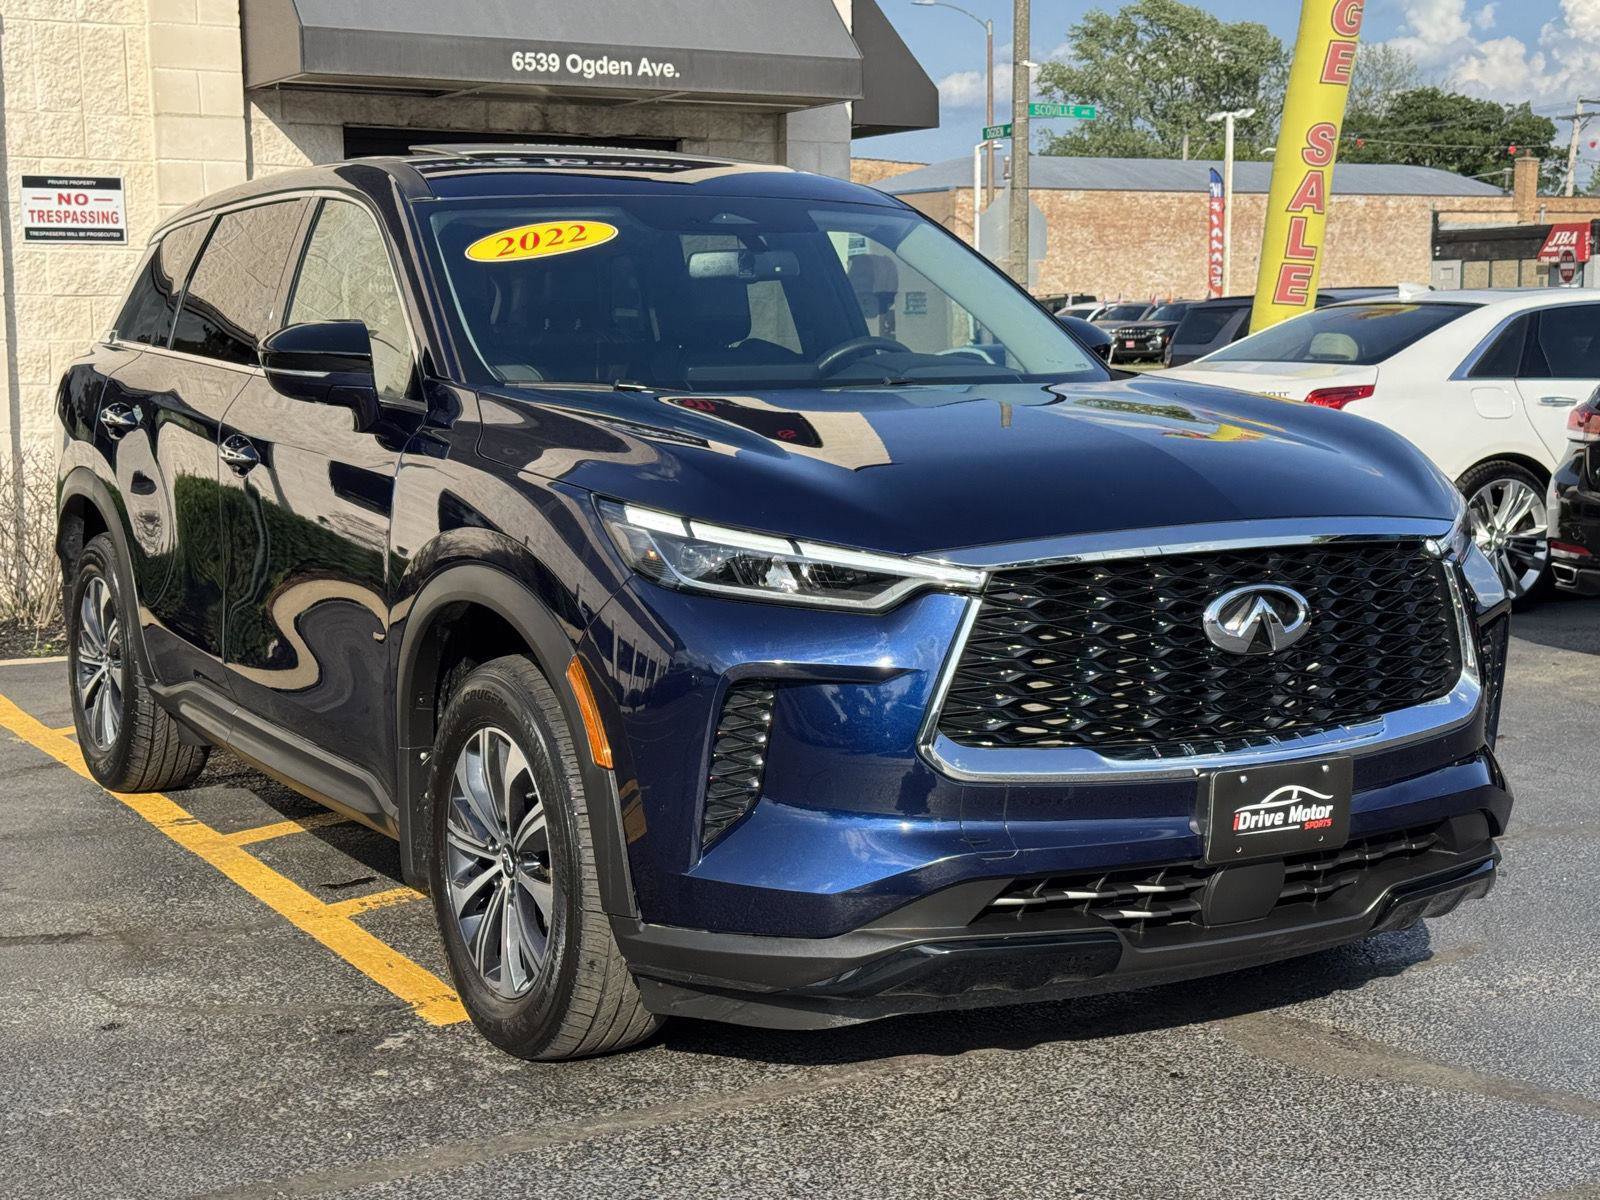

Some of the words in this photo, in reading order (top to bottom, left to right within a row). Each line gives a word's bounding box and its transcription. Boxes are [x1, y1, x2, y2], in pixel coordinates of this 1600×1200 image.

[511, 51, 561, 73] 6539
[565, 53, 633, 79] Ogden
[637, 57, 681, 78] Ave.
[1034, 104, 1075, 116] SCOVILLE
[986, 127, 1004, 139] OGDEN
[57, 192, 89, 206] NO
[28, 209, 120, 224] TRESPASSING
[1272, 122, 1336, 306] SALE
[496, 225, 588, 257] 2022
[1548, 231, 1578, 246] JBA
[1232, 809, 1284, 831] iDrive
[1288, 804, 1333, 822] Motor
[1303, 818, 1333, 830] SPORTS
